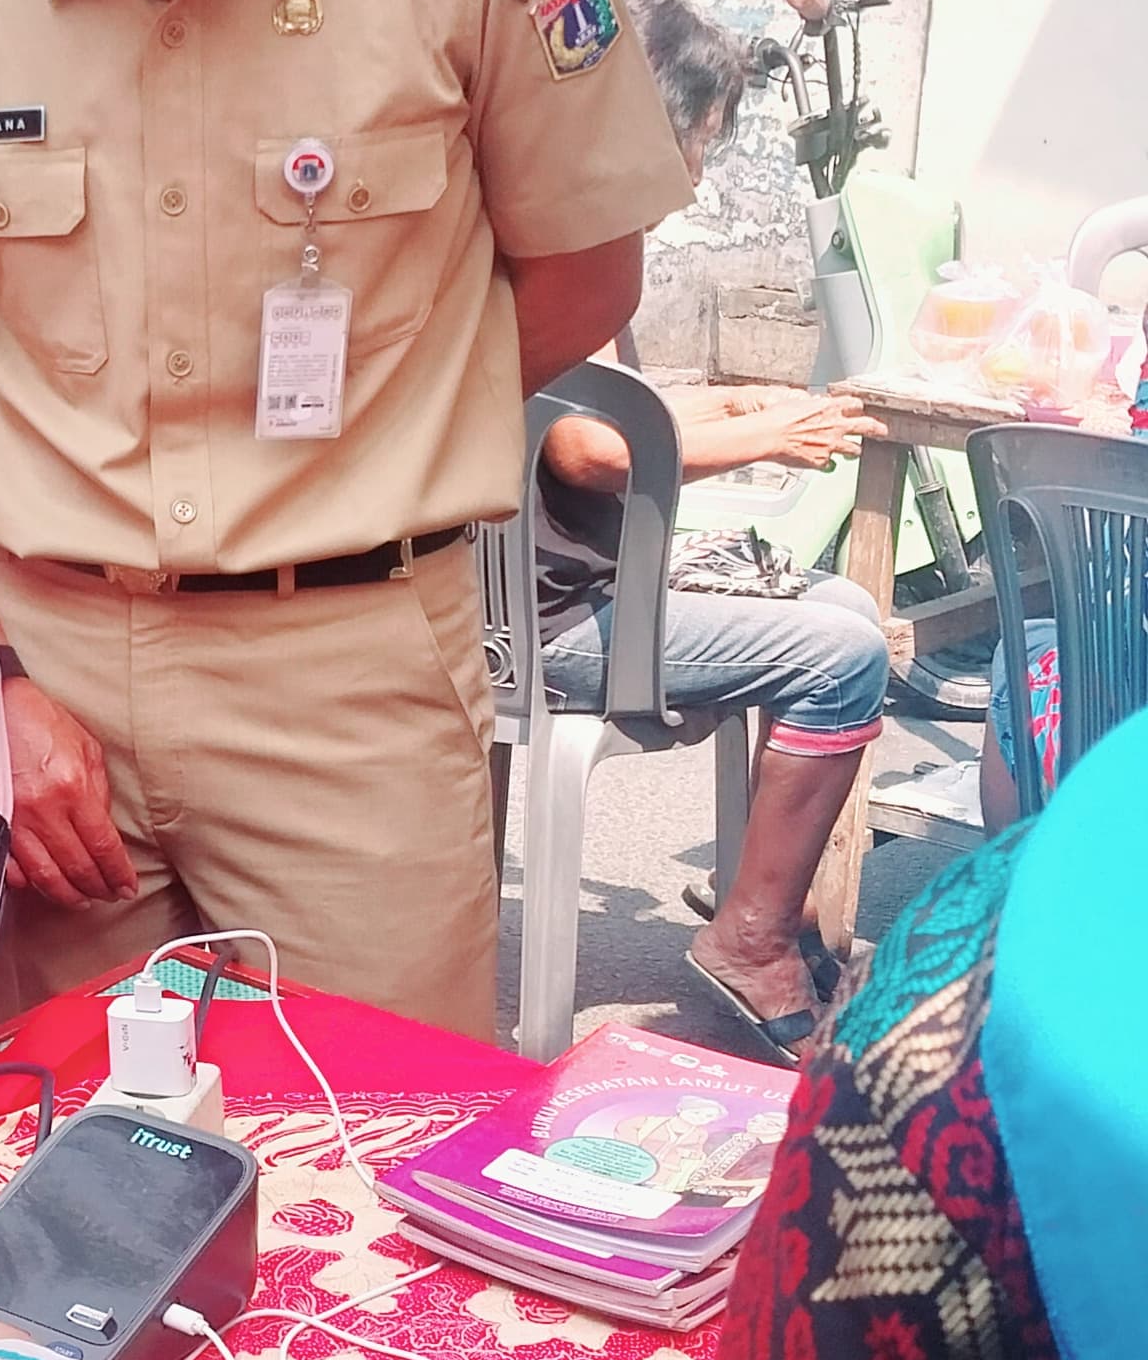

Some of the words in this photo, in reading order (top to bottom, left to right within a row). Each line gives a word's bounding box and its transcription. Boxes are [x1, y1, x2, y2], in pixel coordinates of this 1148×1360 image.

[530, 1103, 555, 1140] BUKU
[551, 1075, 658, 1112] KESEHATAN
[664, 1075, 759, 1095] LANJUT
[762, 1088, 794, 1104] US
[130, 1127, 194, 1161] iTrust
